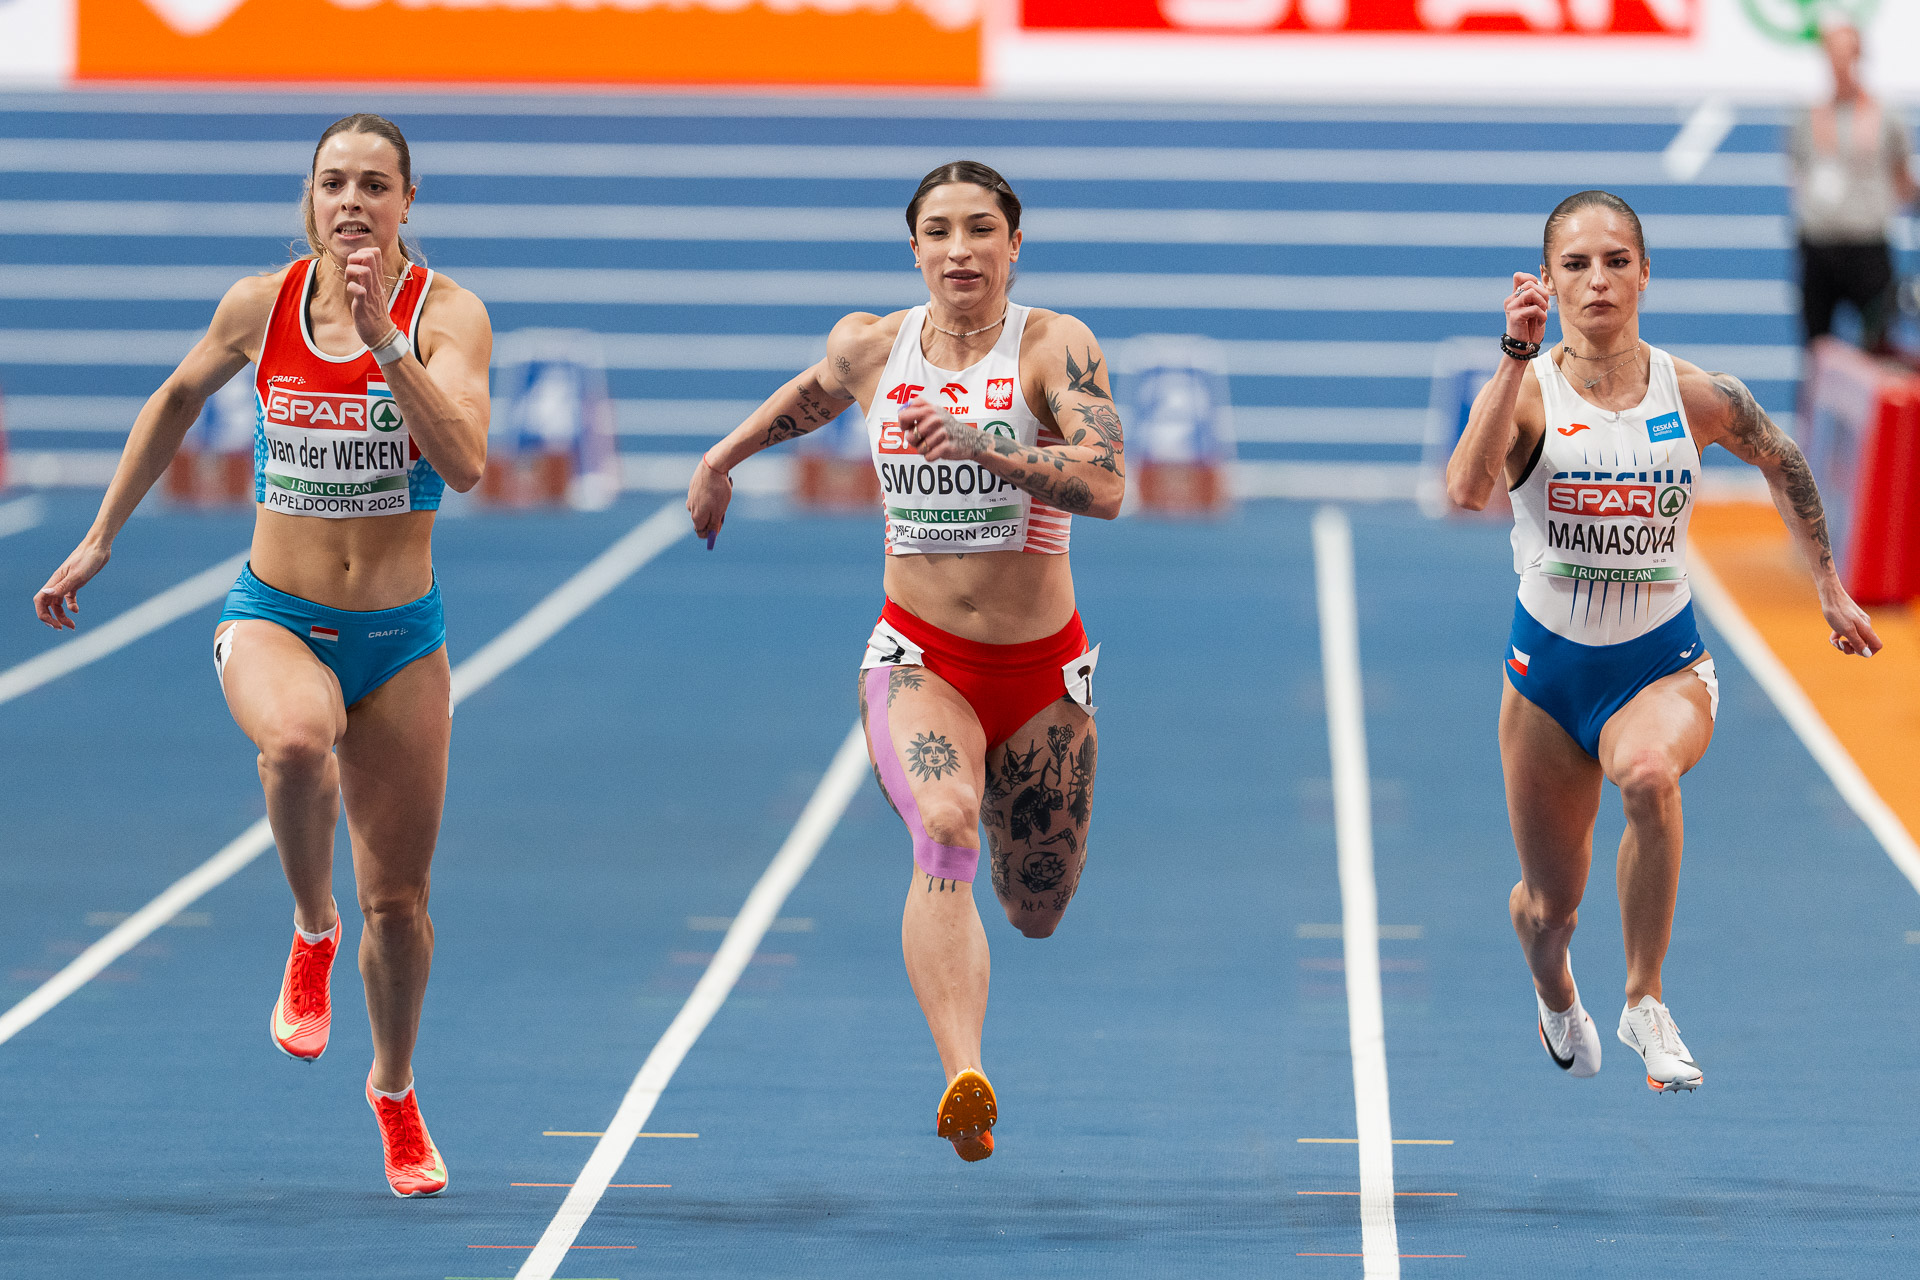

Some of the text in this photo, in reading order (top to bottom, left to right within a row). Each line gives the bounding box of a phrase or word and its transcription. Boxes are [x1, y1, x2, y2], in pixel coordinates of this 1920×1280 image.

[271, 375, 299, 384] CRAFT
[269, 395, 365, 426] SPAR
[943, 406, 969, 415] LEN
[268, 436, 404, 470] van der WEKEN
[297, 481, 324, 495] RUN
[269, 491, 405, 513] APELDOORN 2025
[1551, 487, 1654, 514] SPAR
[911, 510, 938, 522] RUN
[981, 524, 1019, 540] 2025
[1548, 516, 1678, 556] MANASOVÁ
[1571, 566, 1577, 577] I
[1578, 567, 1608, 581] RUN
[368, 629, 399, 639] CRAFT
